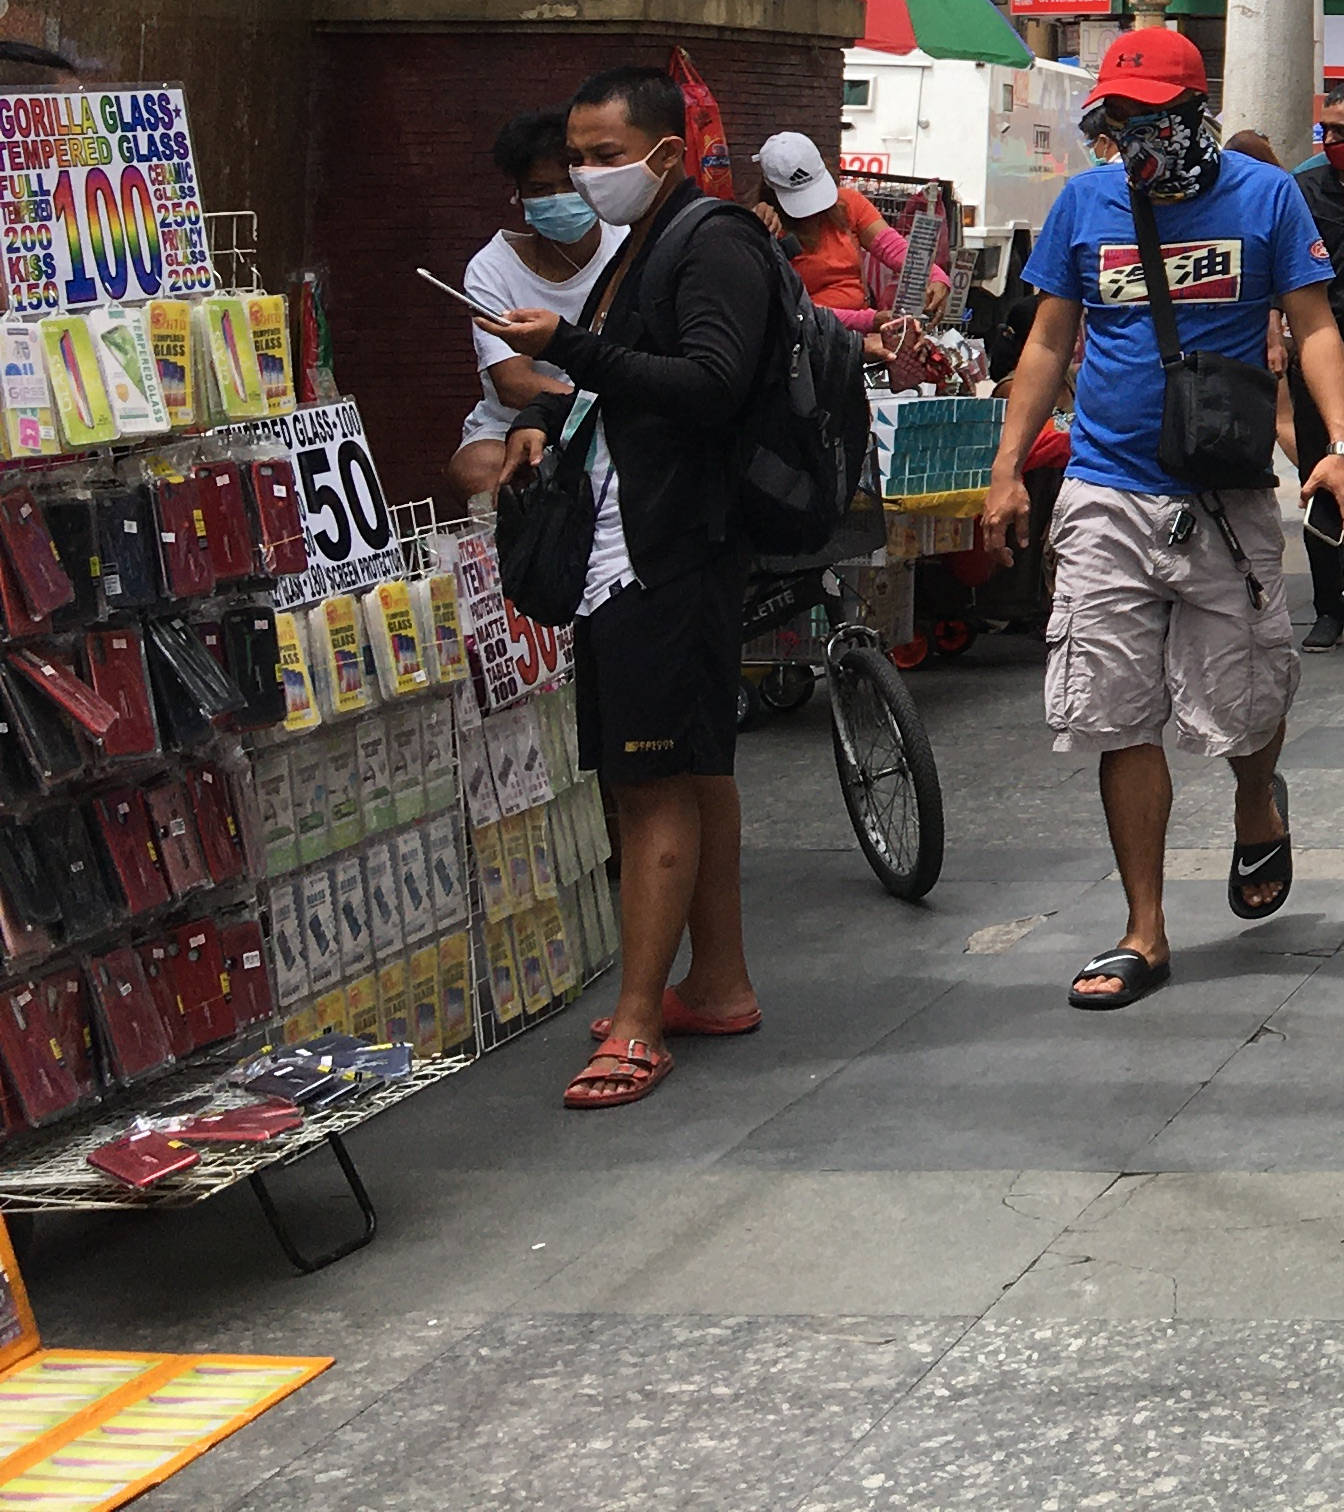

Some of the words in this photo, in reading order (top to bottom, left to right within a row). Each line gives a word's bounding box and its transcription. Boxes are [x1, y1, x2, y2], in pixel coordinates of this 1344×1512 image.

[0, 97, 98, 138] GORILLA
[100, 93, 174, 134] GLASS
[0, 136, 112, 172] TEMPERED
[118, 131, 189, 163] GLASS
[0, 173, 50, 200] FULL
[153, 186, 196, 201] GLASS
[157, 201, 200, 228] 250
[4, 224, 52, 254] 200
[53, 164, 163, 304] 100
[7, 253, 56, 284] KISS
[165, 251, 206, 267] GLASS
[168, 266, 211, 292] 200
[12, 281, 59, 312] 150
[154, 344, 185, 358] GLASS
[254, 337, 282, 351] GLASS
[131, 318, 150, 378] TEMPERED
[146, 380, 164, 424] GLASS
[293, 410, 335, 448] GLASS
[338, 404, 361, 438] 100
[297, 440, 390, 562] 50
[325, 555, 361, 589] SCREEN
[388, 618, 413, 633] GLASS
[476, 616, 507, 645] MATTE
[332, 633, 356, 649] GLASS
[483, 638, 508, 664] 80
[486, 656, 516, 686] TABLET
[491, 677, 518, 705] 100
